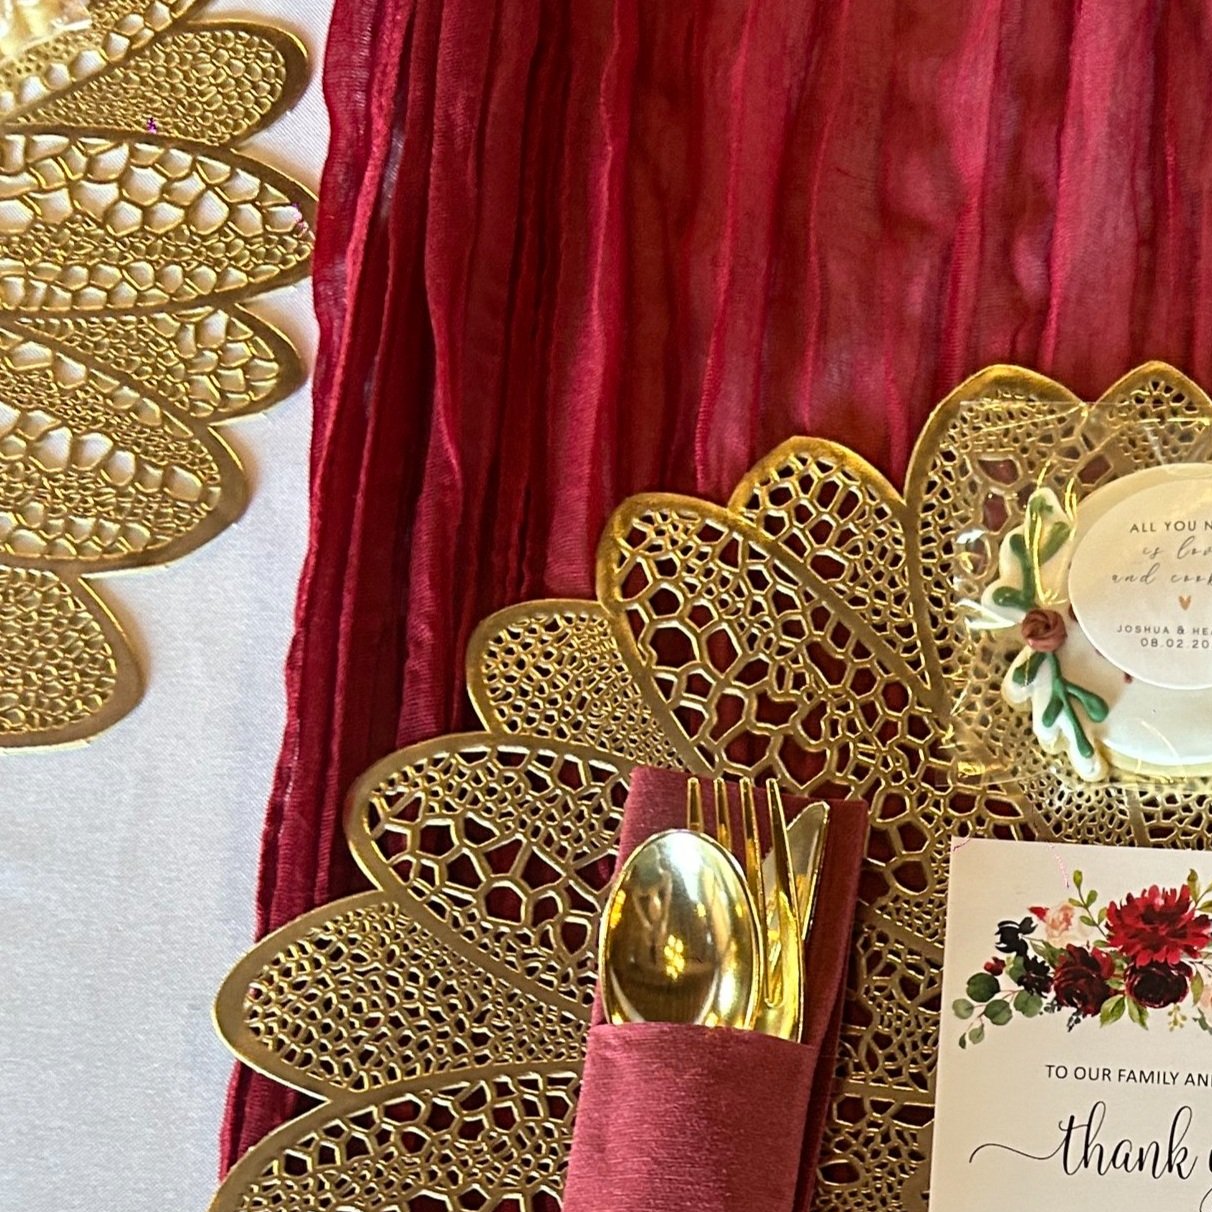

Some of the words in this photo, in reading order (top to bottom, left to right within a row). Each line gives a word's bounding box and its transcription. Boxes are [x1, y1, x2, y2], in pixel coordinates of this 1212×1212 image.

[1129, 522, 1157, 534] ALL
[1164, 519, 1197, 532] YOU
[1142, 545, 1164, 560] is
[1111, 562, 1161, 585] and
[1116, 624, 1170, 635] JOSHUA
[1176, 625, 1185, 636] &
[1044, 1064, 1069, 1080] TO
[1073, 1066, 1112, 1082] OUR
[1117, 1068, 1180, 1086] FAMILY
[968, 1100, 1199, 1181] thank
